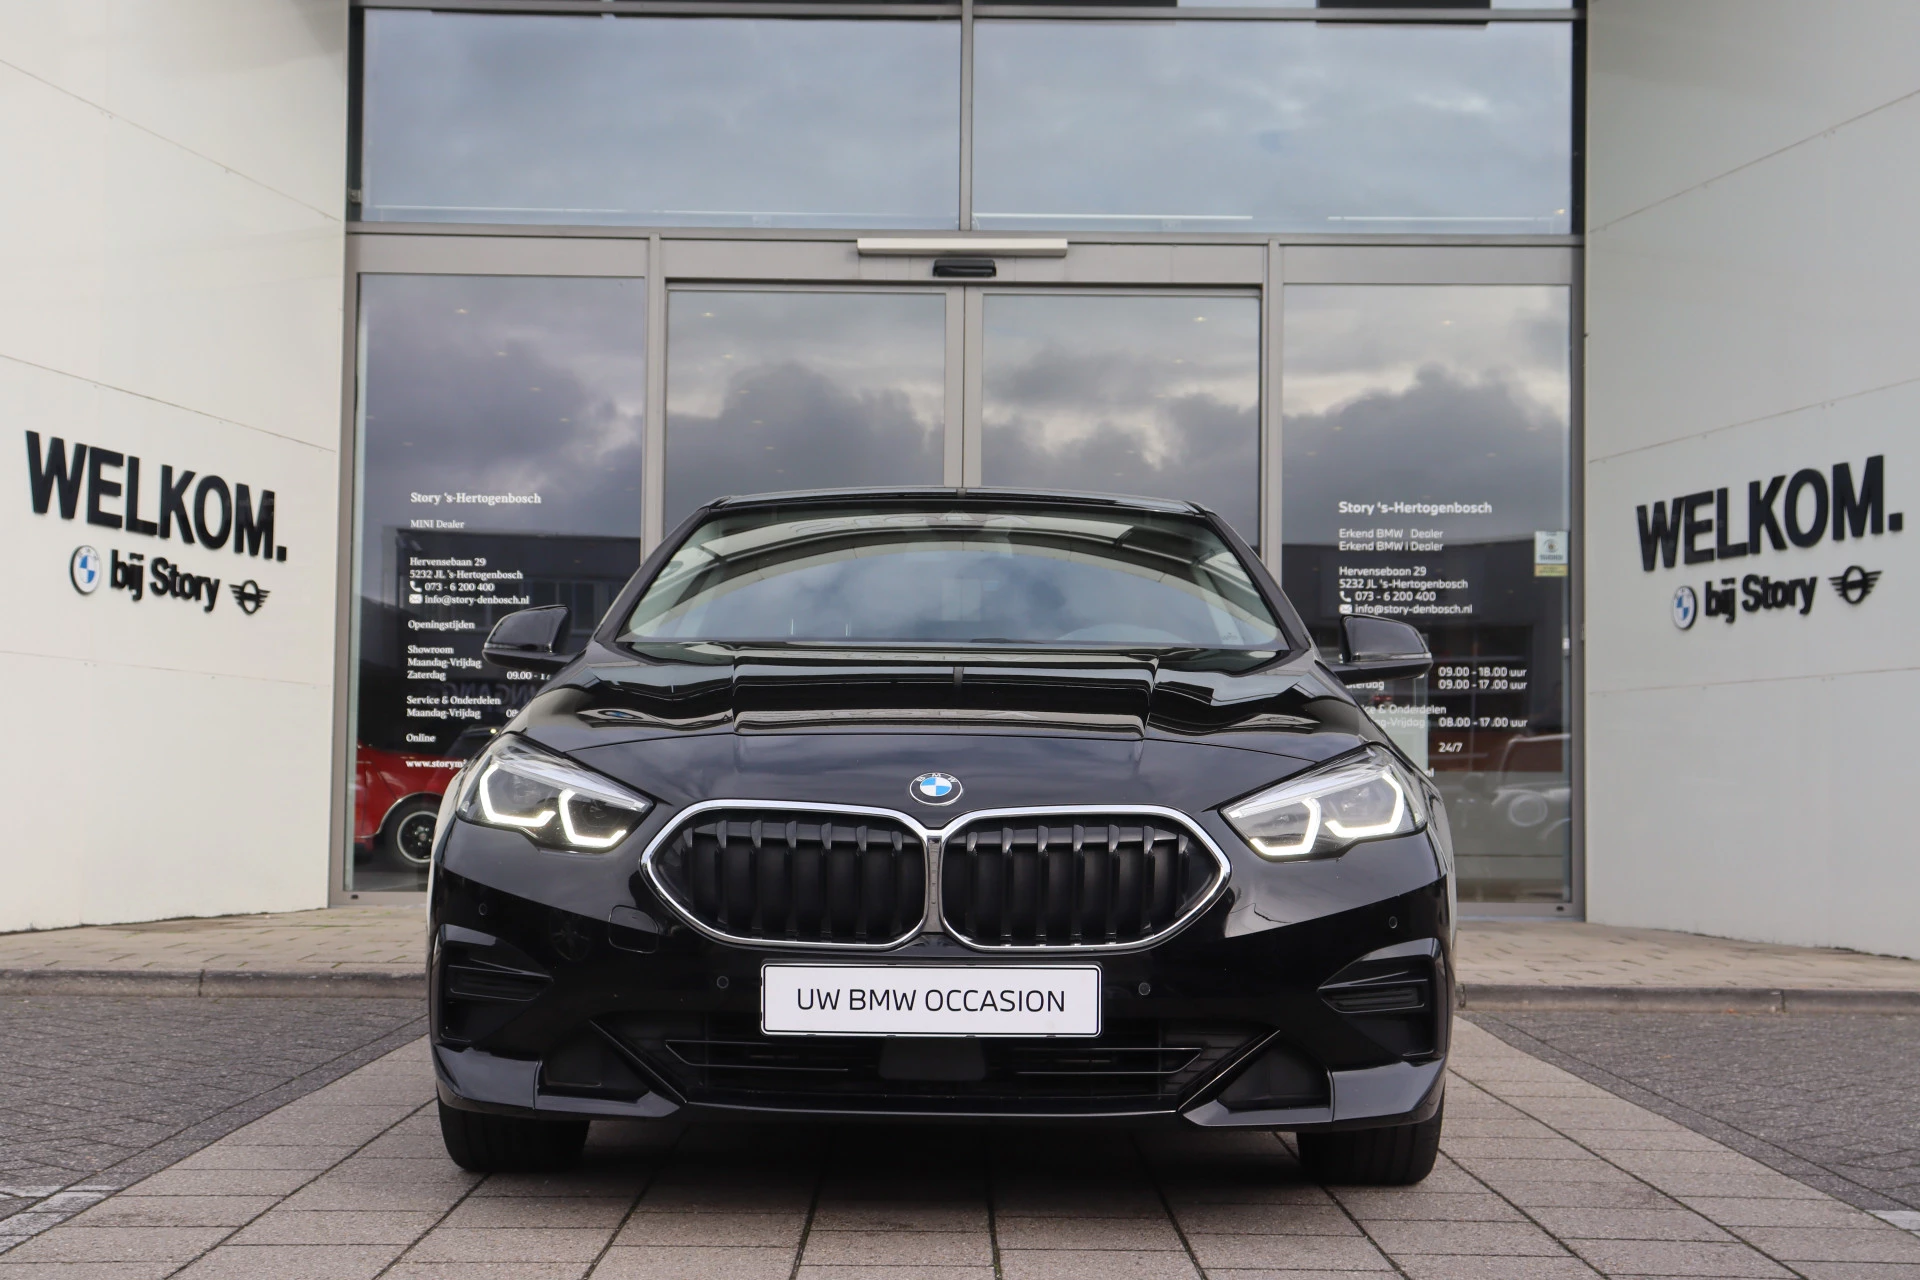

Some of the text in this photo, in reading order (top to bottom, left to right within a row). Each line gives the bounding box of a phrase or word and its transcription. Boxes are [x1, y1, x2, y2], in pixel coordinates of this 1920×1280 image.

[25, 430, 287, 562] WELKOM.
[410, 492, 441, 505] Story
[1338, 501, 1374, 515] Story
[1636, 454, 1903, 573] WELKOM.
[410, 519, 464, 529] MINI Dealer
[1339, 529, 1443, 538] Erkend BMW Dealer
[1339, 541, 1374, 551] Erkend
[1376, 541, 1403, 551] BMW
[1410, 541, 1443, 551] Dealer
[409, 557, 487, 567] Hervensebaan 29
[409, 570, 433, 579] 5232
[433, 570, 445, 580] JL
[1339, 566, 1427, 576] Hervensebaan 29
[110, 549, 220, 613] bij Story
[1339, 579, 1364, 589] 5232
[1366, 579, 1377, 589] JL
[424, 583, 442, 592] 073
[450, 583, 456, 592] 6
[458, 583, 475, 592] 200
[476, 583, 495, 592] 400
[424, 595, 530, 606] info@story-denbosch.nl
[1355, 592, 1374, 601] 073
[1383, 592, 1391, 601] 6
[1393, 592, 1413, 601] 200
[1415, 592, 1436, 601] 400
[1705, 573, 1818, 624] bij Story
[1355, 604, 1472, 615] info@story-denbosch.nl
[408, 620, 475, 631] Openingstijden
[407, 645, 454, 654] Showroom
[407, 657, 482, 669] Maandag-Vrijdag
[407, 670, 446, 682] Zaterdag
[506, 671, 532, 680] 09.00
[1438, 667, 1469, 677] 09.00
[1479, 667, 1507, 677] 18.00
[1509, 669, 1527, 677] uur
[1438, 680, 1469, 690] 09.00
[1479, 680, 1507, 690] 17.00
[1509, 682, 1527, 690] uur
[406, 695, 501, 705] Service & Onderdelen
[406, 708, 481, 720] Maandag-Vrijdag
[1379, 705, 1386, 714] &
[1389, 704, 1446, 714] Onderdelen
[1438, 717, 1469, 727] 08.00
[1479, 717, 1508, 727] 17.00
[406, 733, 436, 743] Online
[1438, 742, 1463, 753] 24/7
[797, 988, 1065, 1012] UW BMW OCCASION
